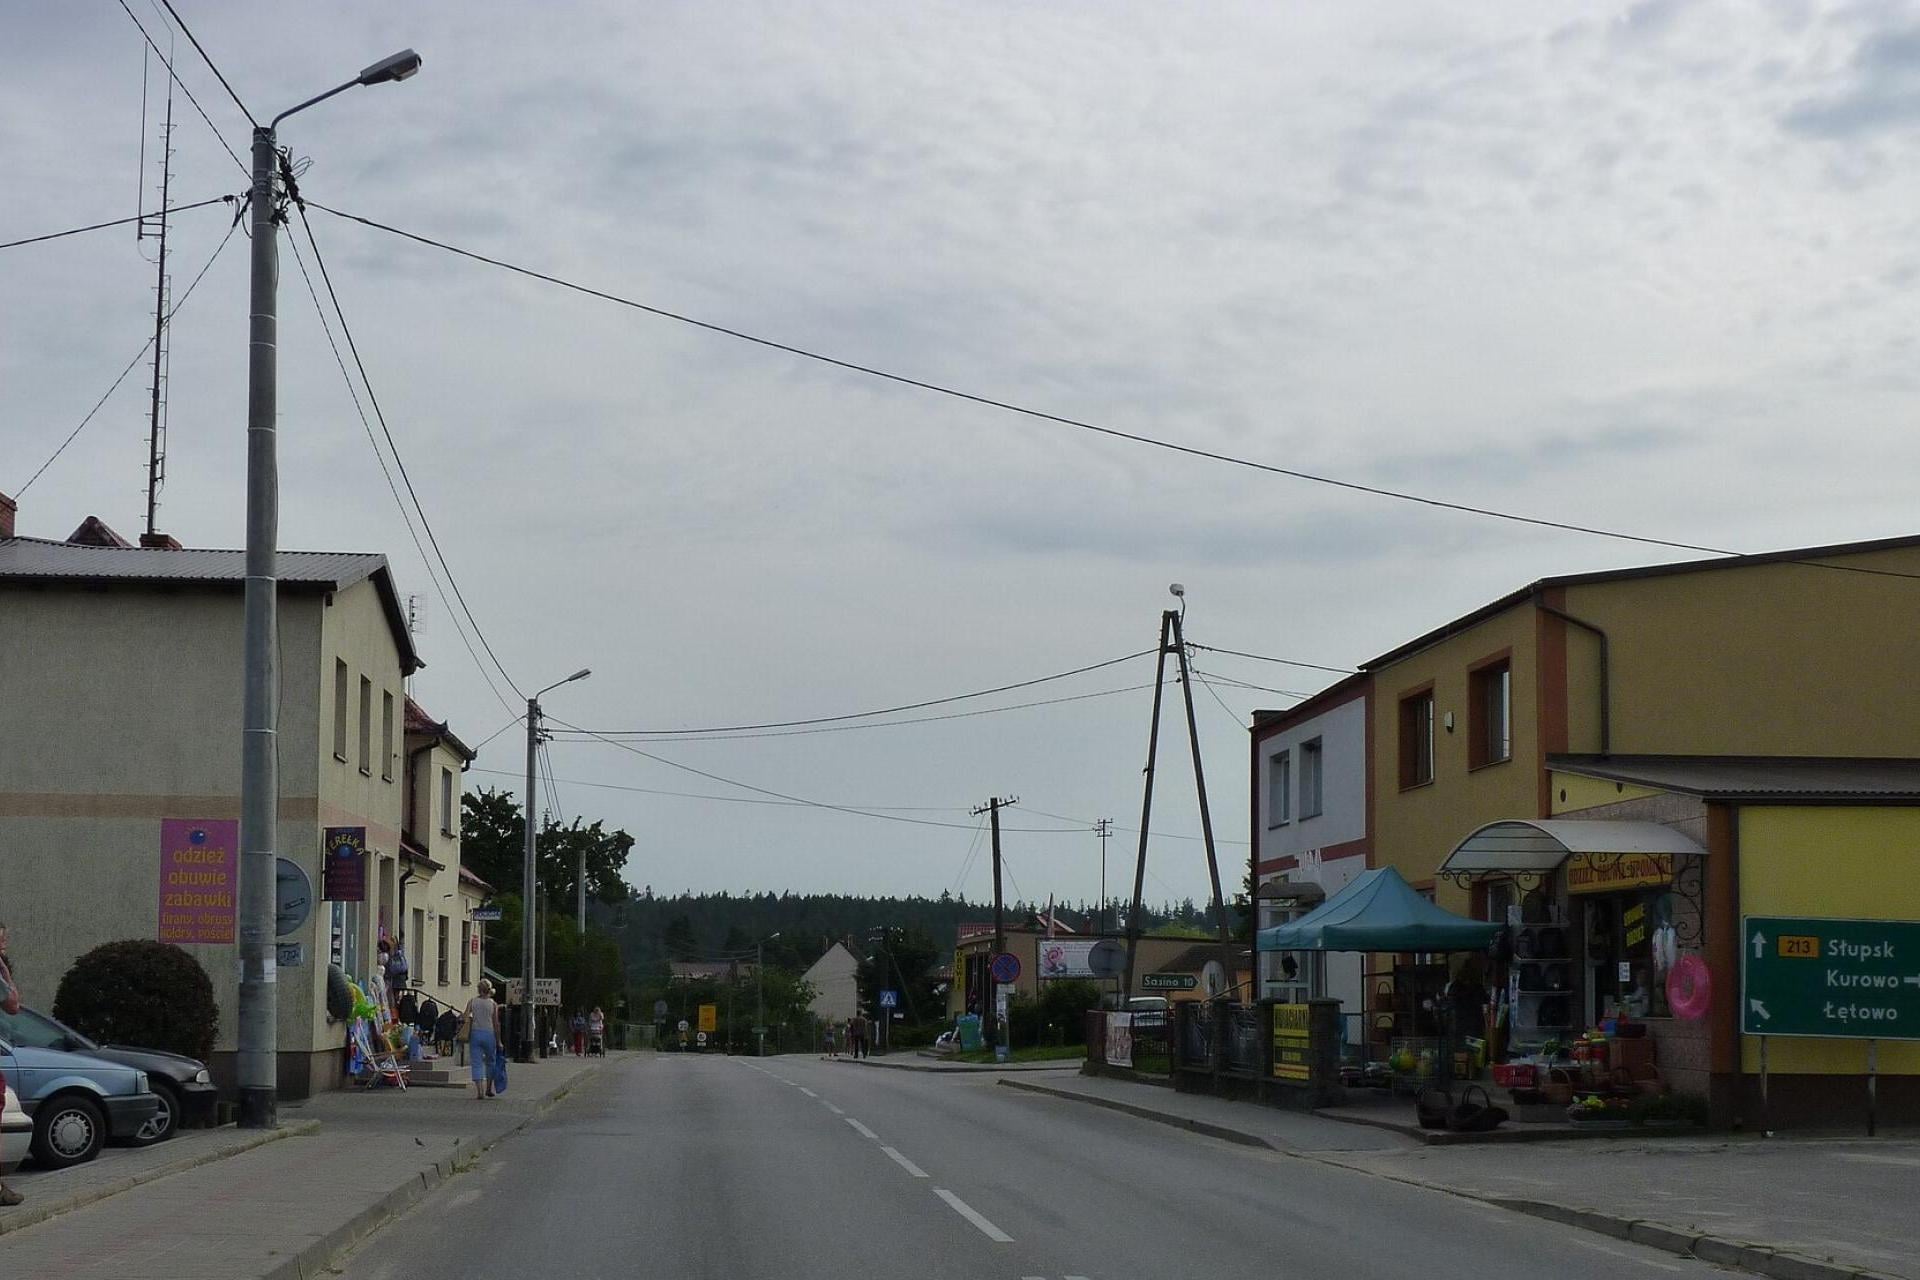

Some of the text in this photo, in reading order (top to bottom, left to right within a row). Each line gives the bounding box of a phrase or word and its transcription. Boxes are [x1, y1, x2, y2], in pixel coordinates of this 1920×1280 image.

[173, 847, 225, 865] odzież
[169, 869, 227, 885] obuwie
[164, 890, 233, 907] zabawki
[1787, 940, 1811, 953] 213
[1827, 939, 1896, 963] Słupsk
[1143, 975, 1195, 988] Sasino 10
[1826, 969, 1899, 988] Kurowo
[1823, 1000, 1898, 1024] Łętowo
